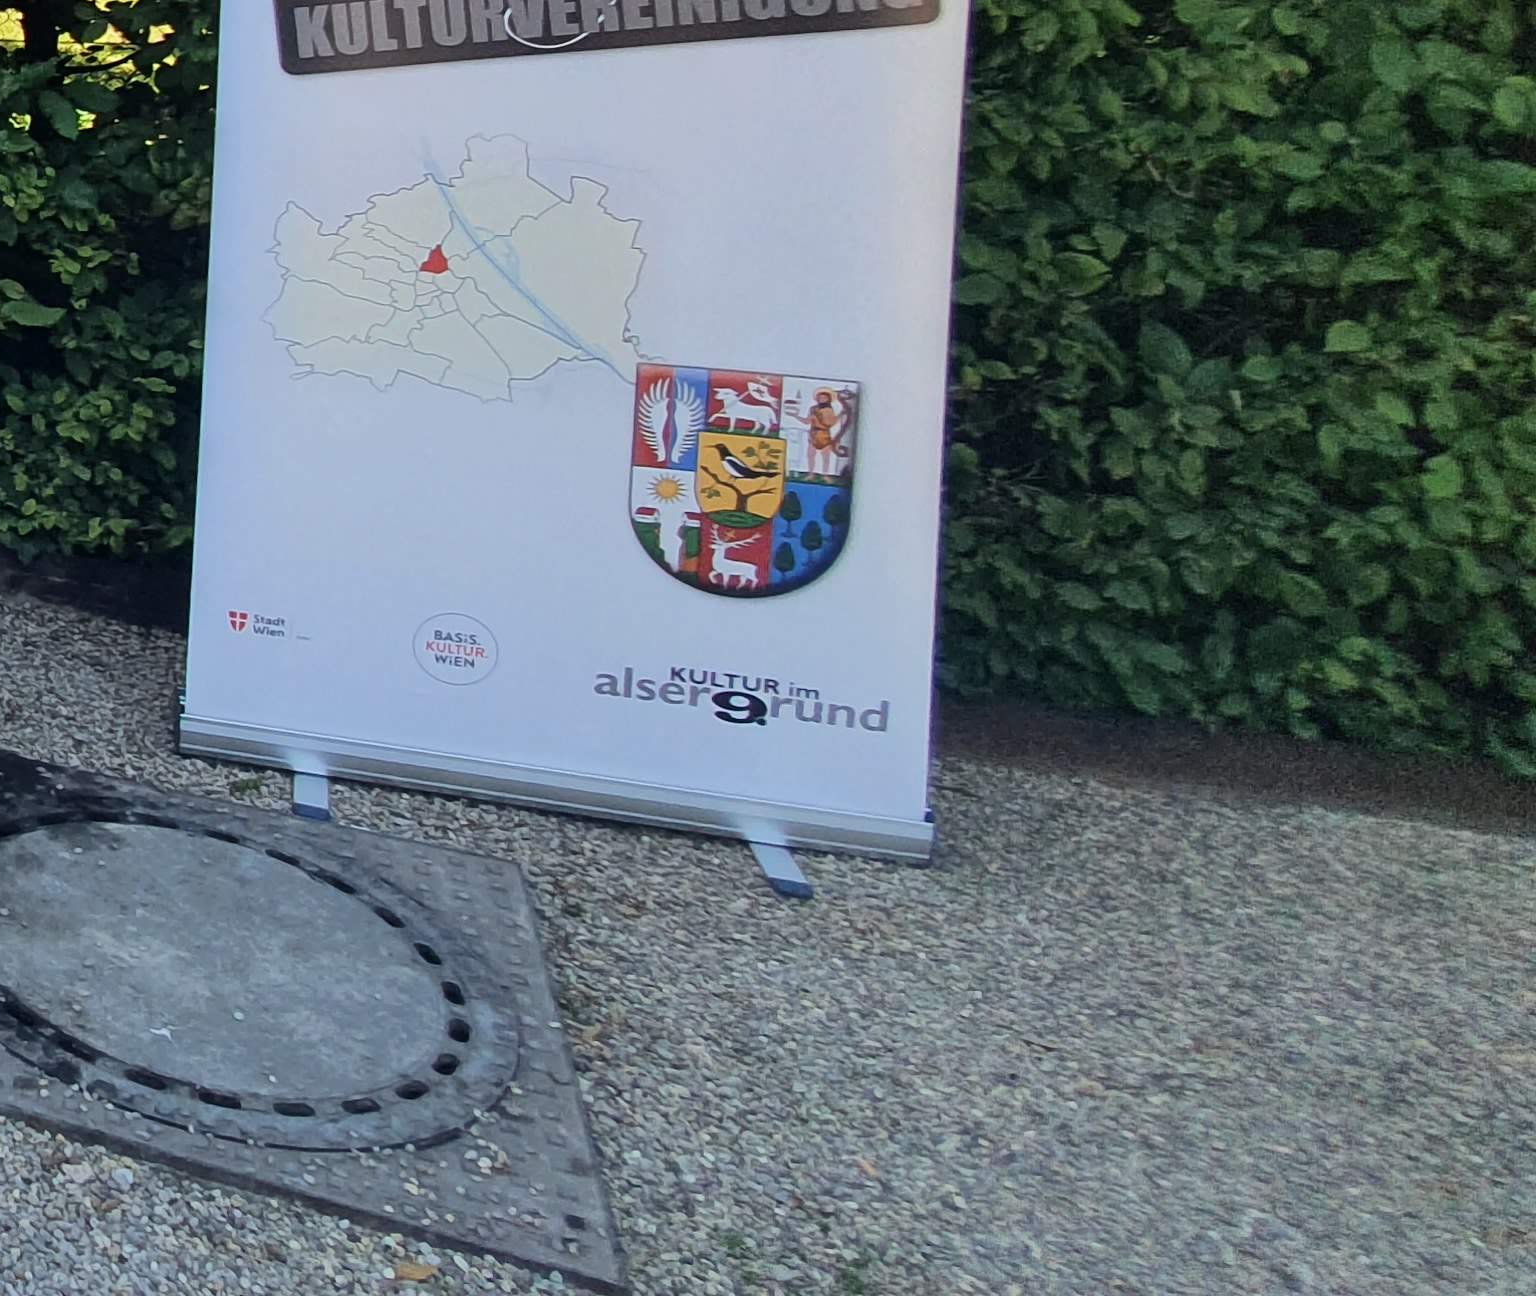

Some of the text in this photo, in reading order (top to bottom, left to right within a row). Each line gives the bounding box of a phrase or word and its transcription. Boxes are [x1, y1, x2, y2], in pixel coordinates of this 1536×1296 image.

[253, 613, 286, 627] Stadt
[252, 624, 285, 638] Wien
[670, 666, 820, 700] KULTUR im
